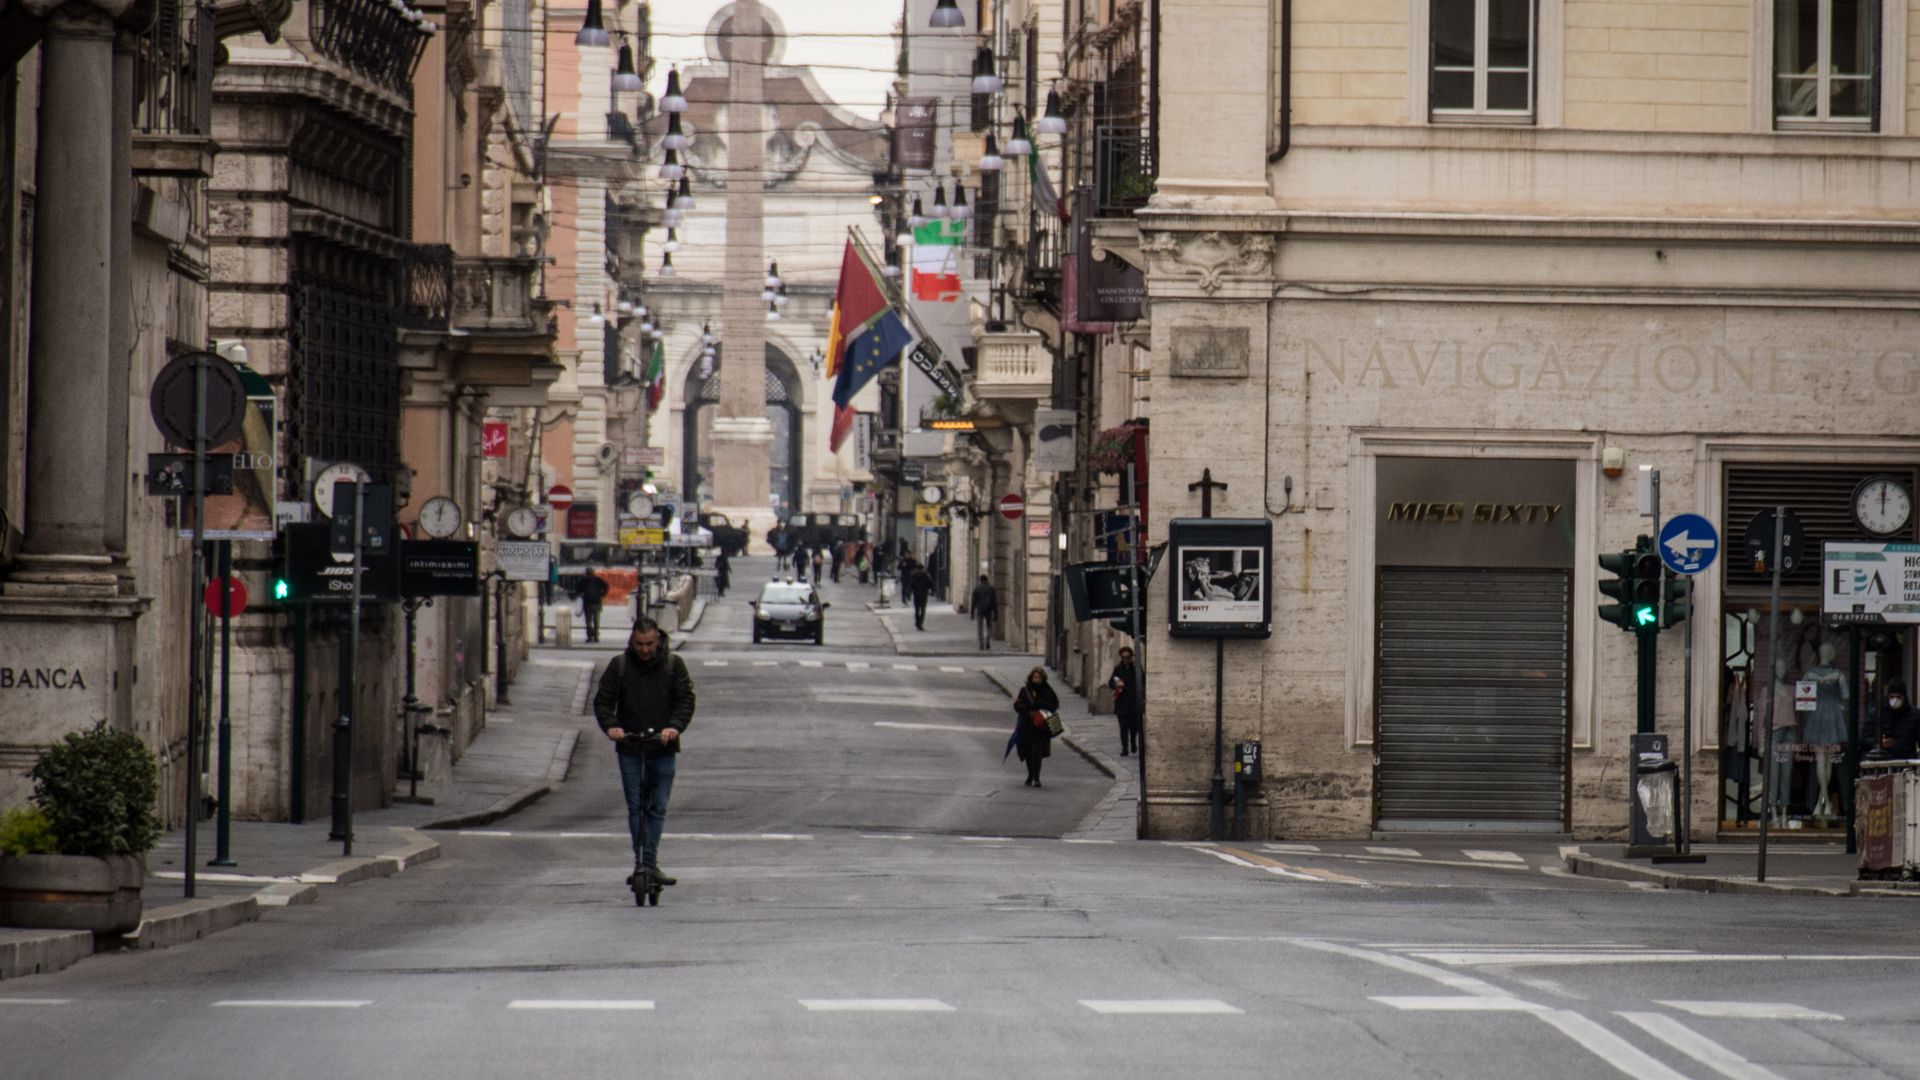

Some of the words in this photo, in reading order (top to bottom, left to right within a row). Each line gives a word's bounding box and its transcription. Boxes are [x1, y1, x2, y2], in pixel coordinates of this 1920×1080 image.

[1302, 337, 1799, 394] NAVIGAZIONE
[1387, 501, 1464, 523] MISS
[1472, 503, 1561, 523] SIXTY
[410, 560, 470, 569] intimissimi
[0, 667, 87, 689] BANCA
